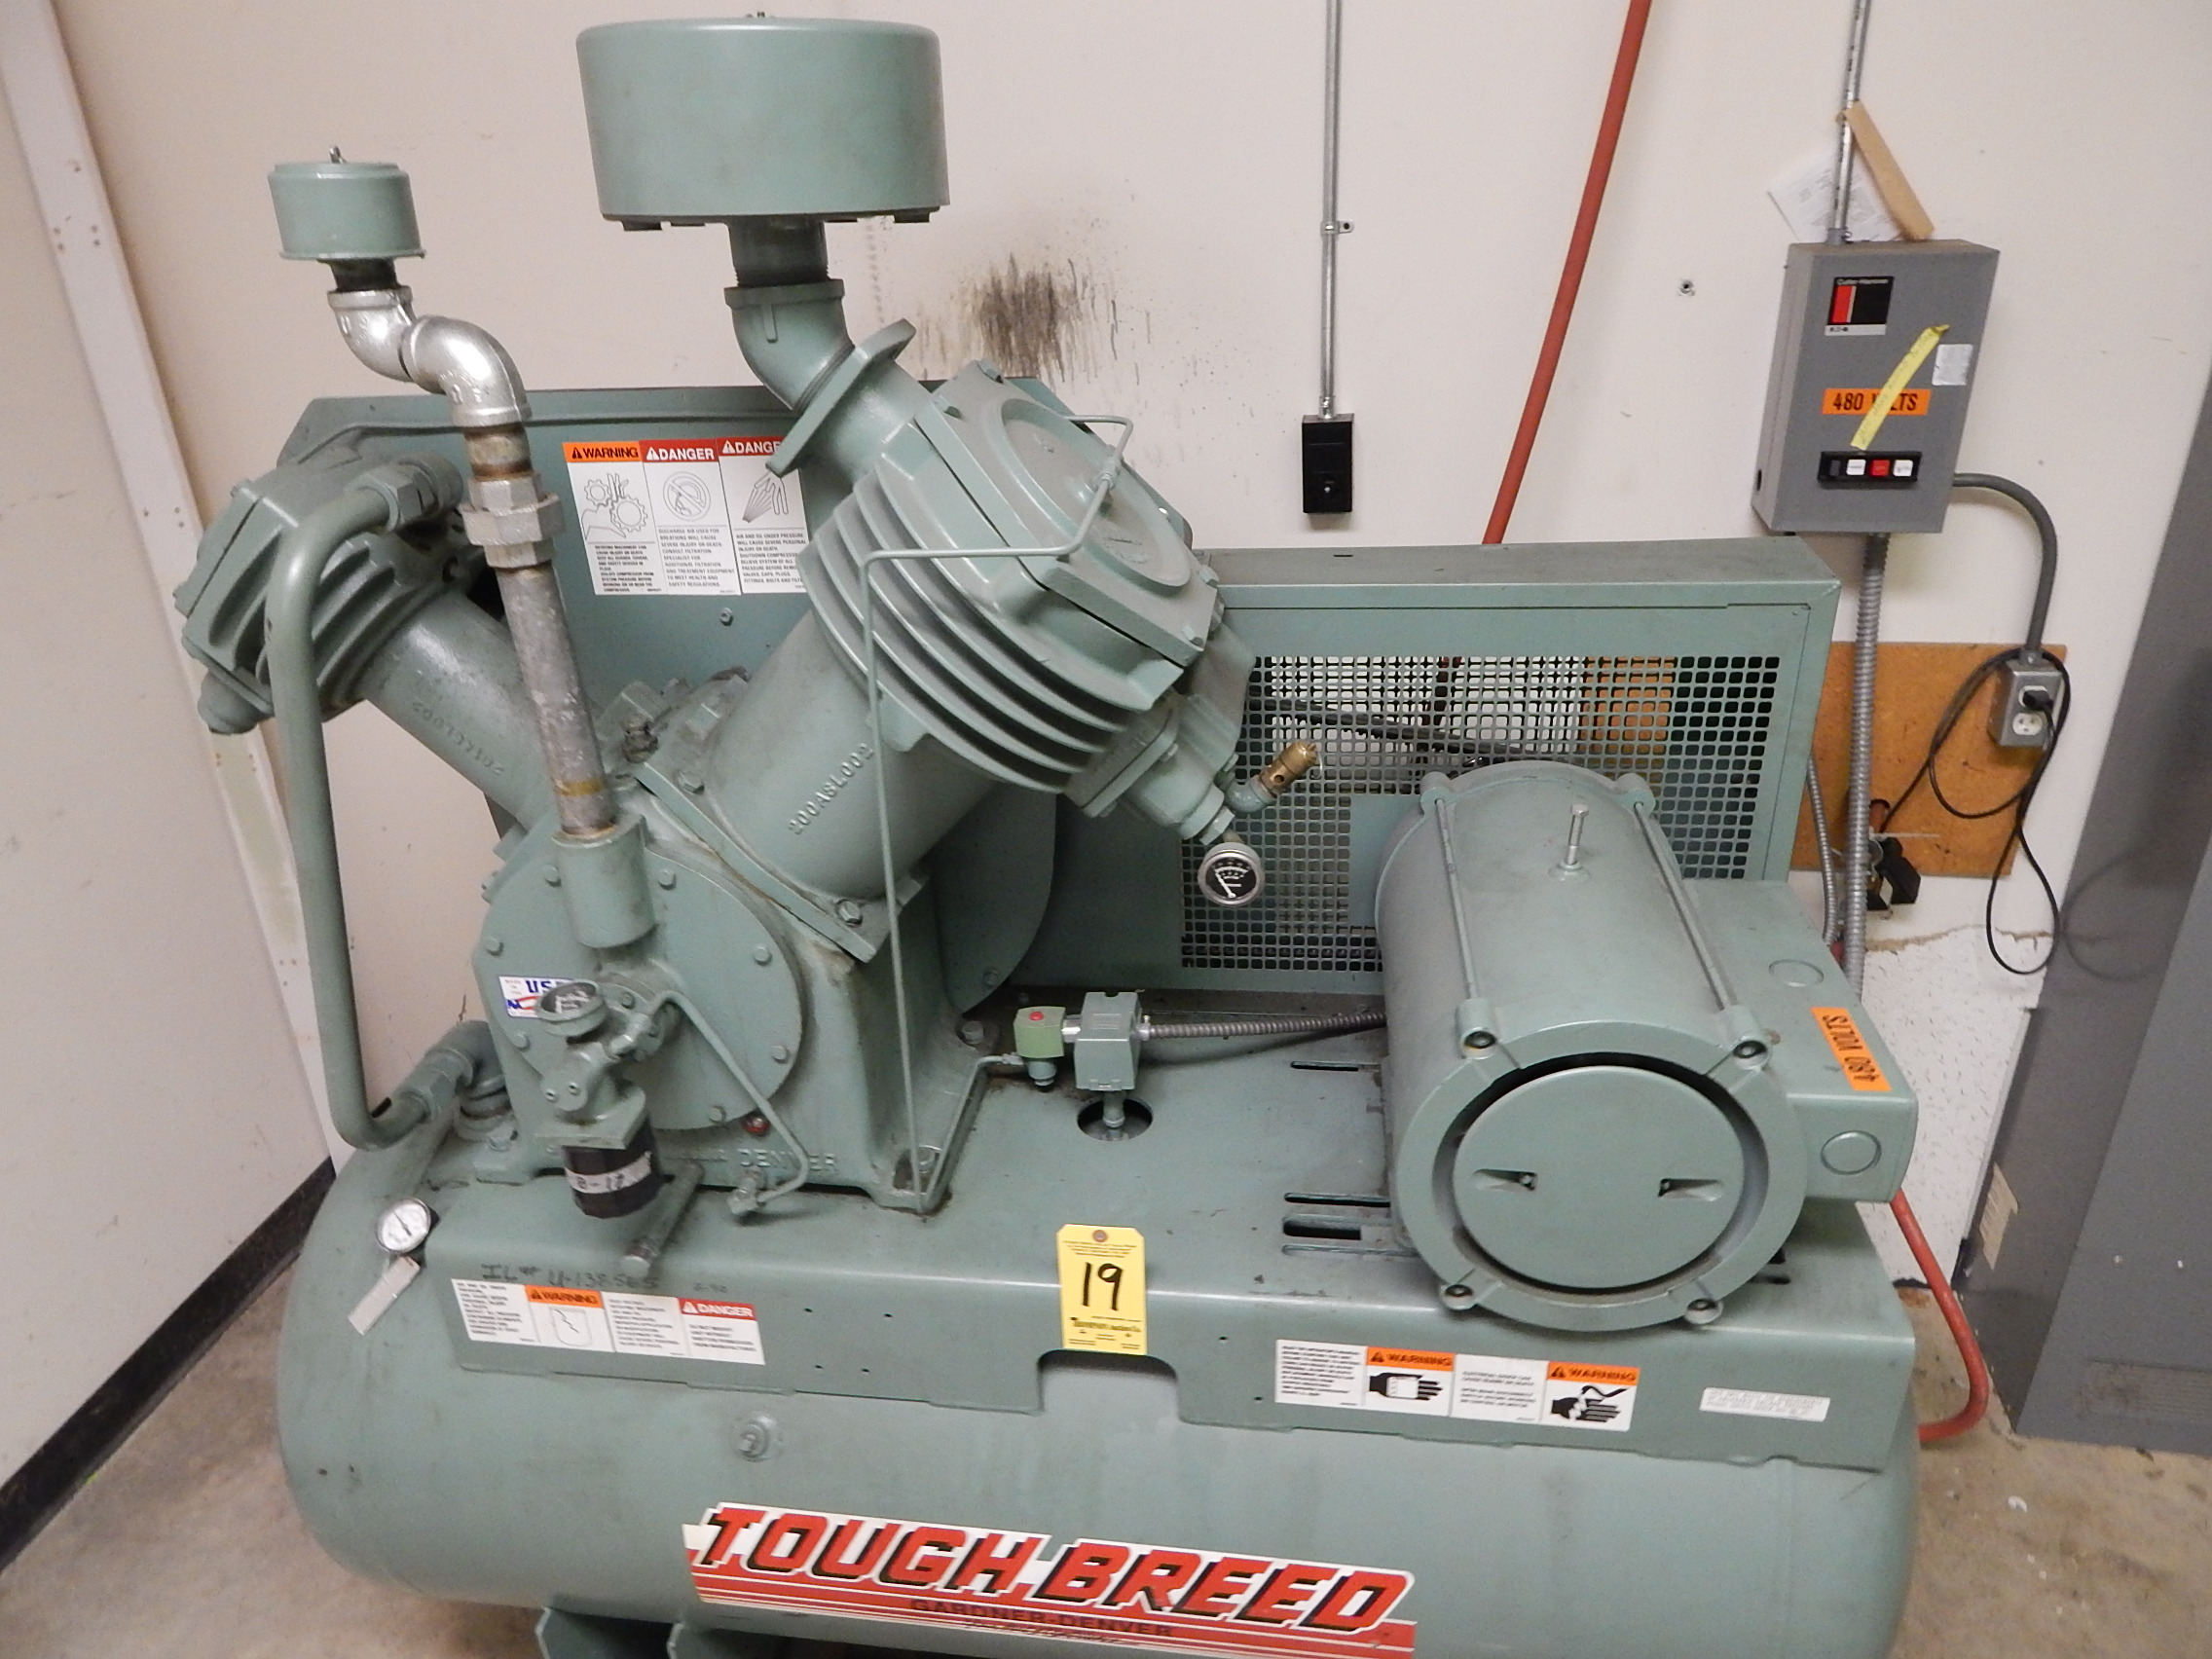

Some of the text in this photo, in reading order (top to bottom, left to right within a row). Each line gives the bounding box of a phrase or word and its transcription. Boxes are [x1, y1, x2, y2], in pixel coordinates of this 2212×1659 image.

[1833, 392, 1864, 411] 480
[584, 447, 639, 459] WARNING
[735, 440, 781, 454] DANGE
[659, 448, 715, 461] DANGER
[1083, 1263, 1124, 1311] 19
[542, 1290, 599, 1305] WARNING
[696, 1303, 755, 1317] DANGER
[1387, 1352, 1452, 1366] WARNING
[1568, 1367, 1637, 1382] WARNING
[700, 1506, 1408, 1631] TOUGH BREED
